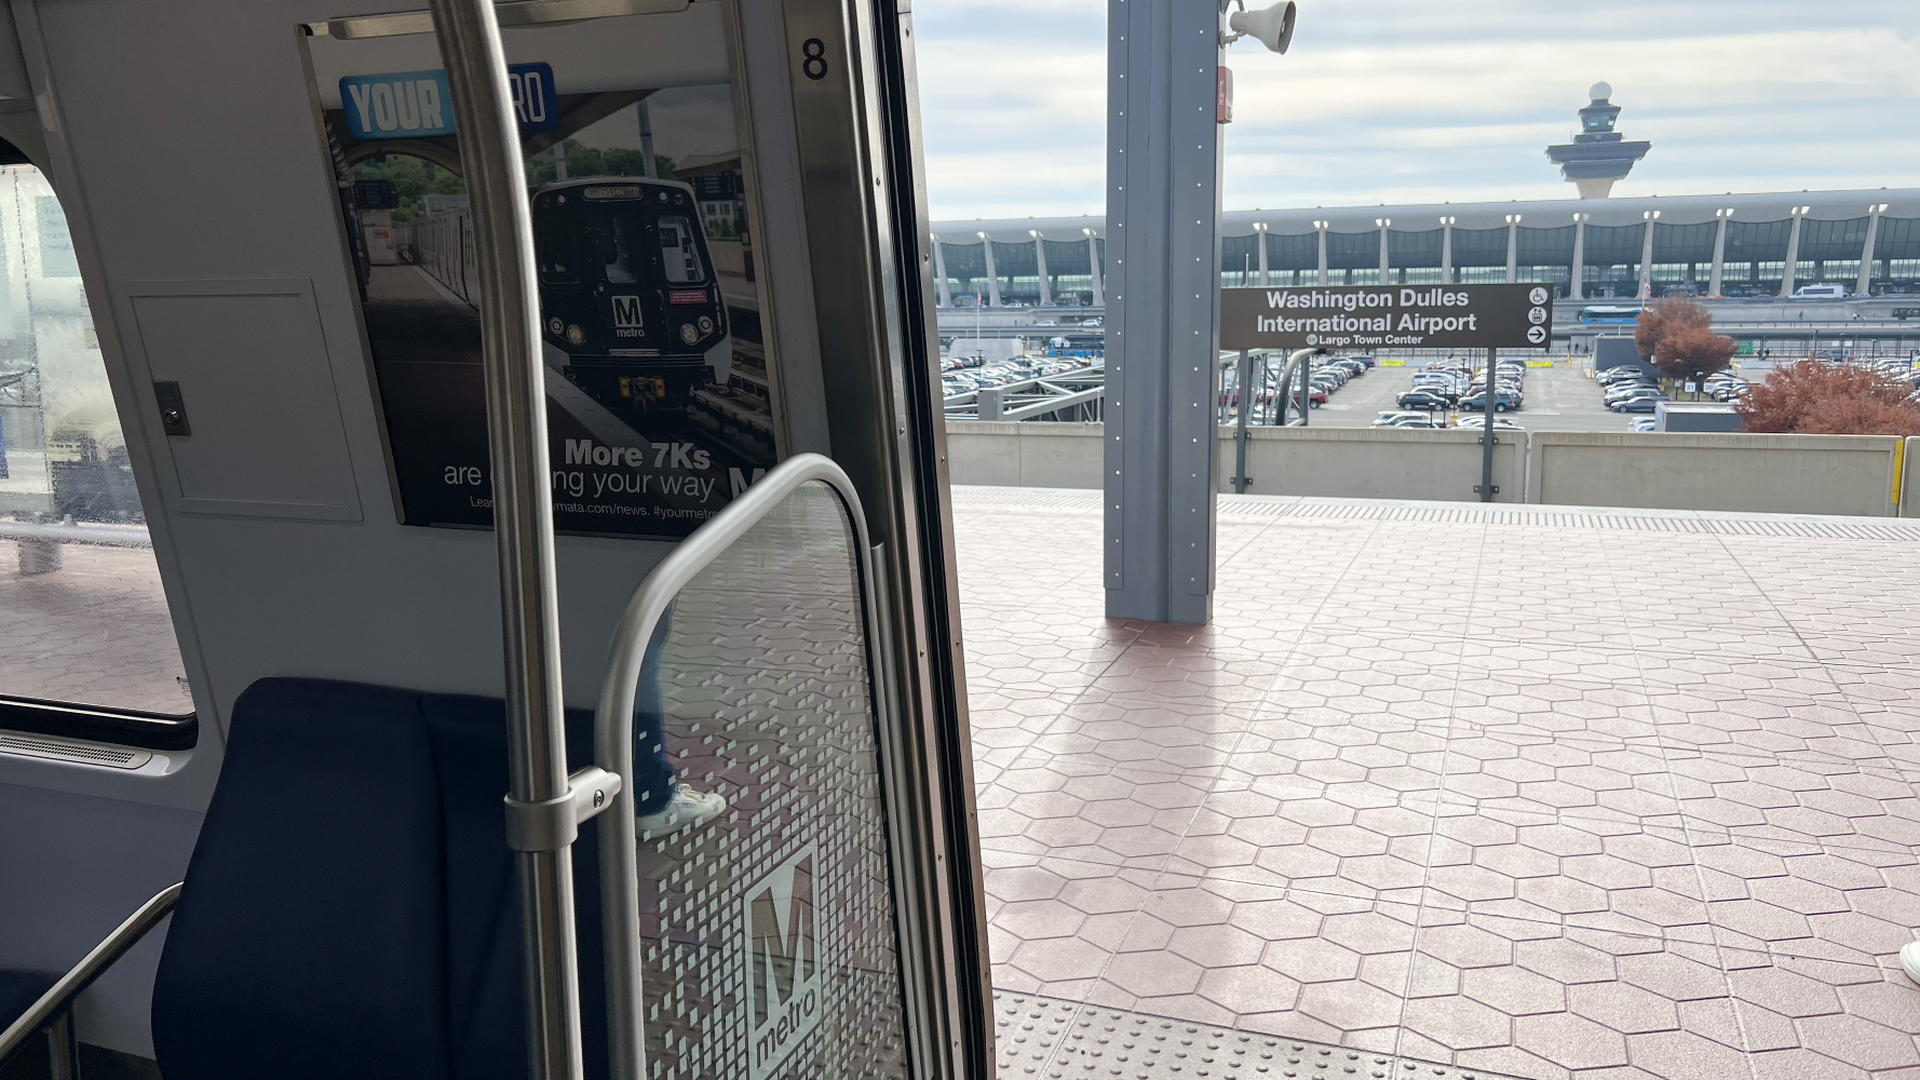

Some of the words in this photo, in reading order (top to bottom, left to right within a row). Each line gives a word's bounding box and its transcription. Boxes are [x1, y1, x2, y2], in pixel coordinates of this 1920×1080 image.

[802, 37, 828, 81] 8
[348, 79, 445, 133] YOUR
[1266, 290, 1393, 312] Washington
[1400, 288, 1469, 307] Dulles
[1257, 313, 1392, 333] International
[1397, 312, 1477, 335] Airport
[1319, 334, 1351, 347] Largo
[1353, 334, 1382, 345] Town
[1385, 334, 1423, 345] Center
[565, 438, 643, 468] More
[651, 442, 711, 470] 7Ks
[444, 465, 482, 486] are
[593, 472, 653, 498] your
[660, 475, 716, 503] way
[470, 495, 494, 508] Lear
[554, 501, 651, 517] mata.com/news.
[756, 988, 816, 1070] metro
